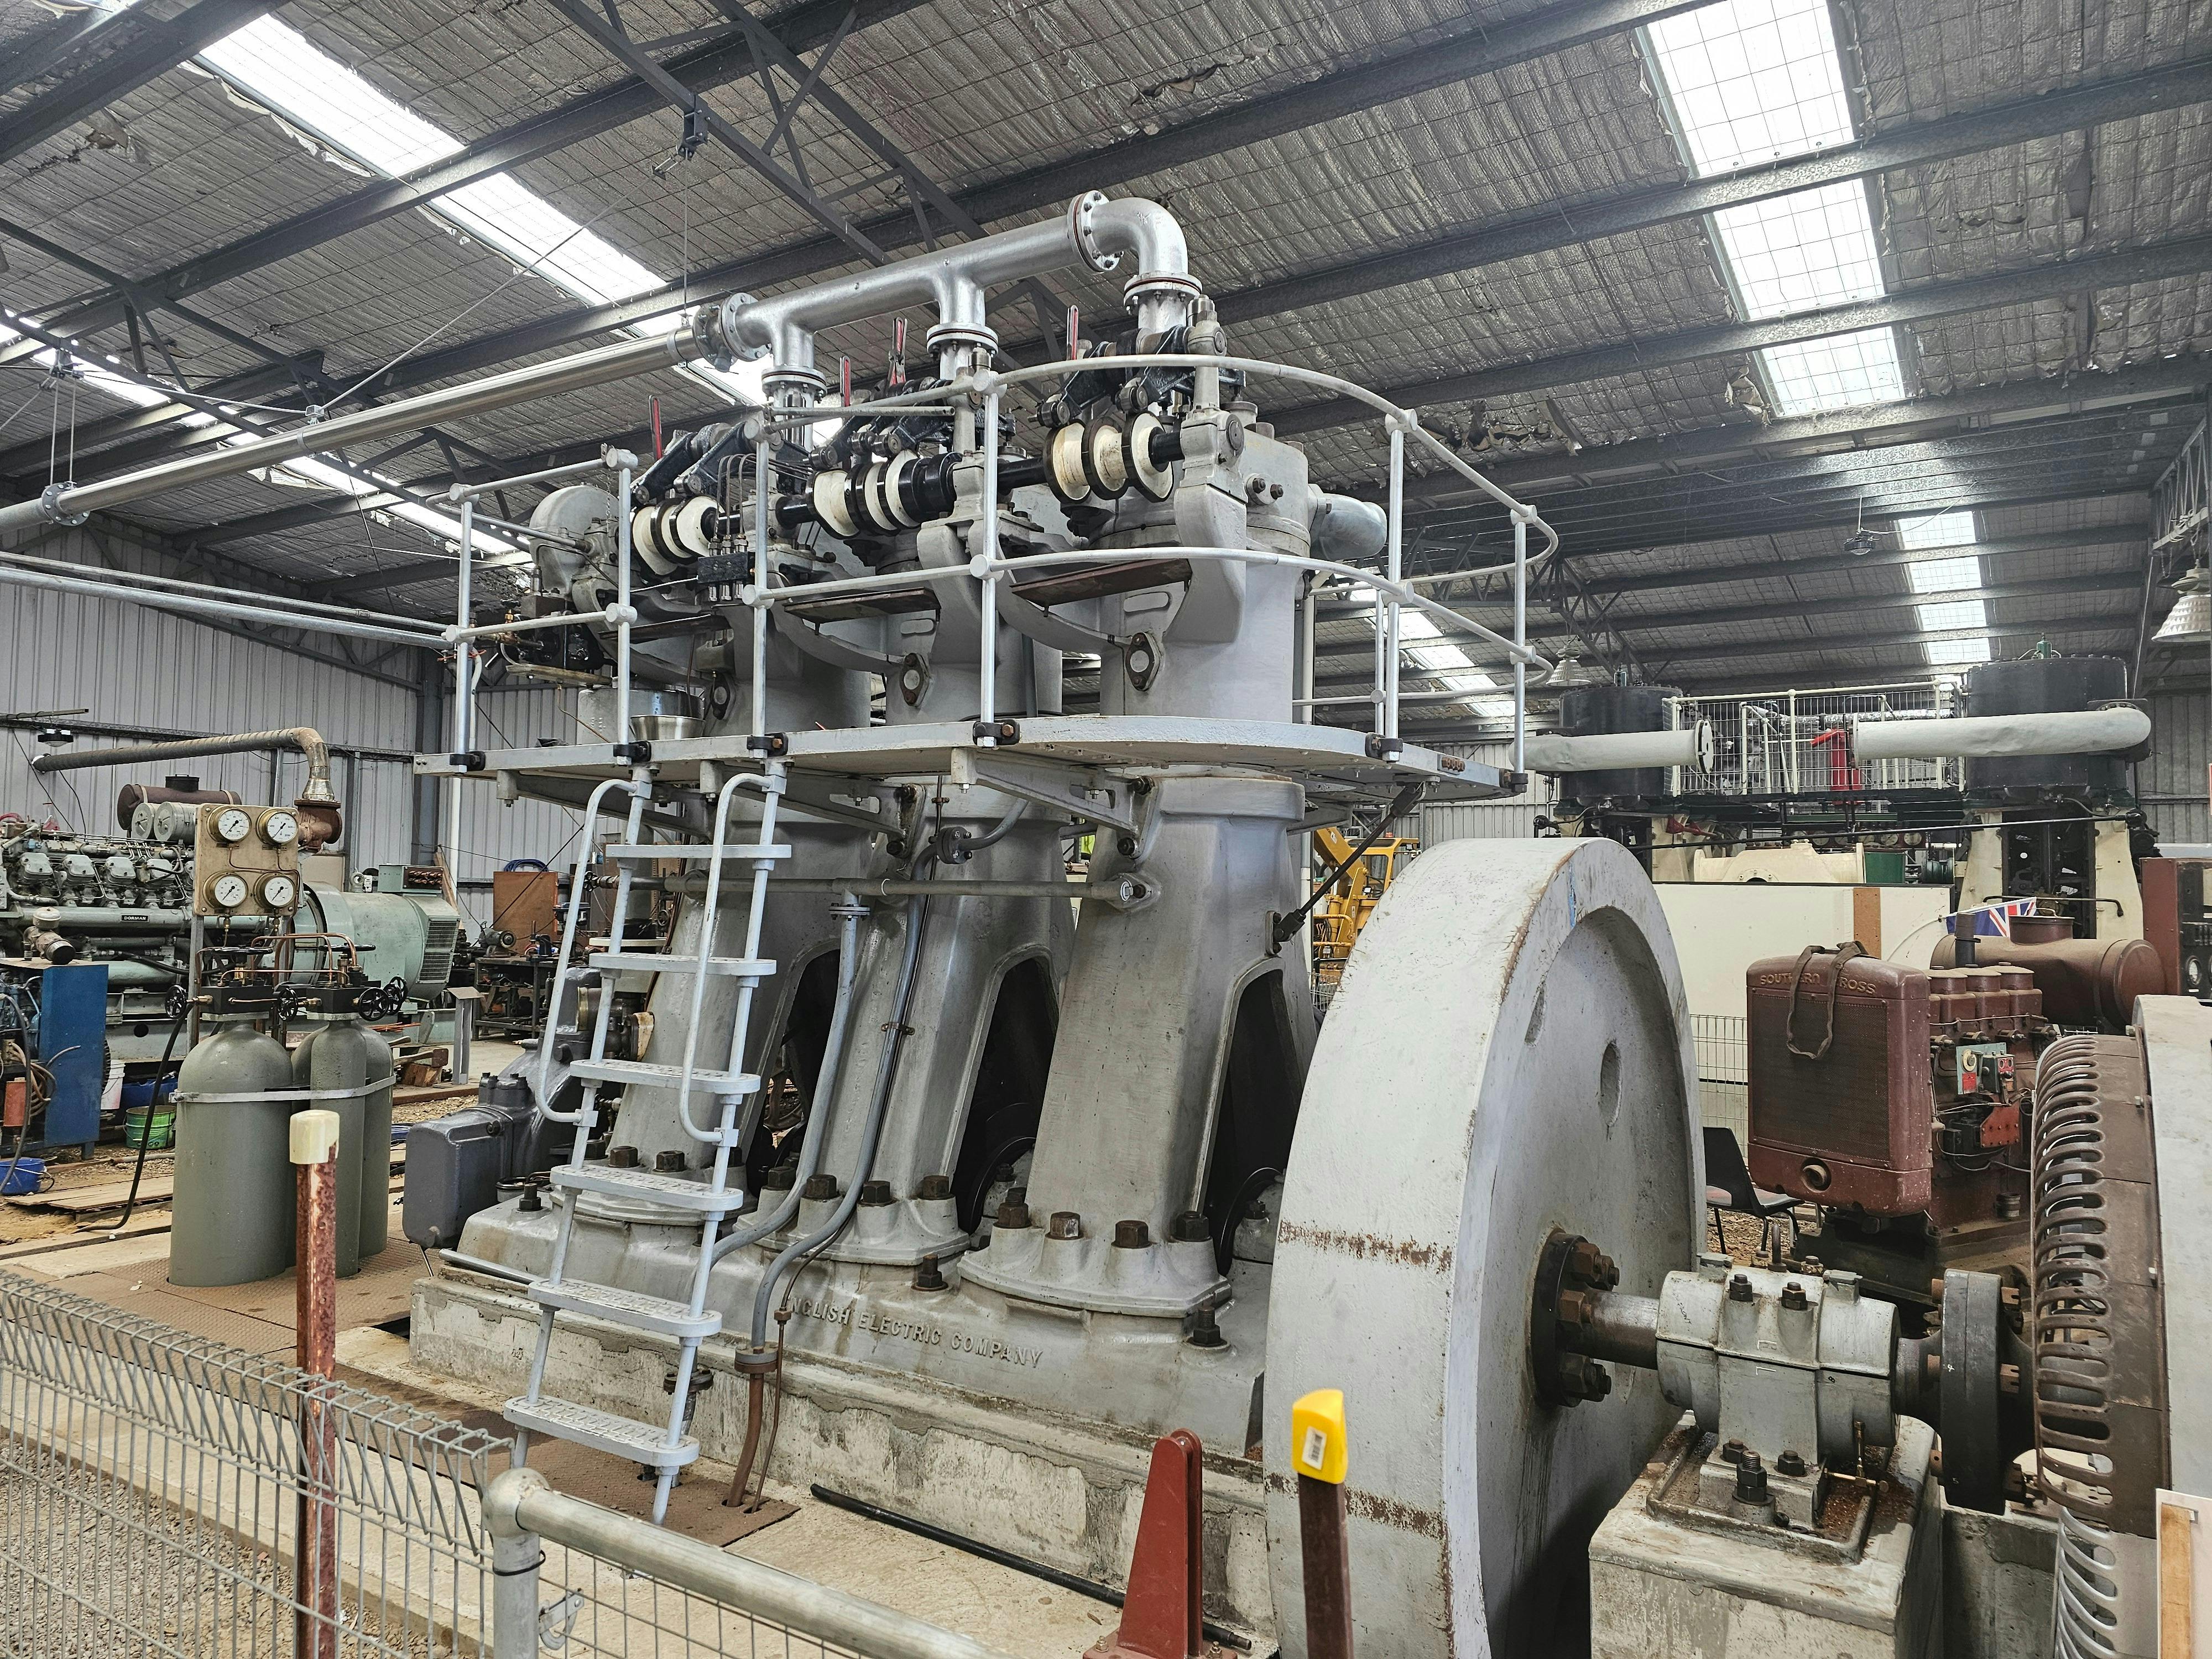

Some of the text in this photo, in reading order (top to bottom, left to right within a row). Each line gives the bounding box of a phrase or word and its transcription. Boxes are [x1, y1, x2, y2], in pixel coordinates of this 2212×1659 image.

[1760, 972, 1876, 994] SOUTHRN ROSS
[787, 1296, 1044, 1369] NGLISH ELECTRIC COMPANY
